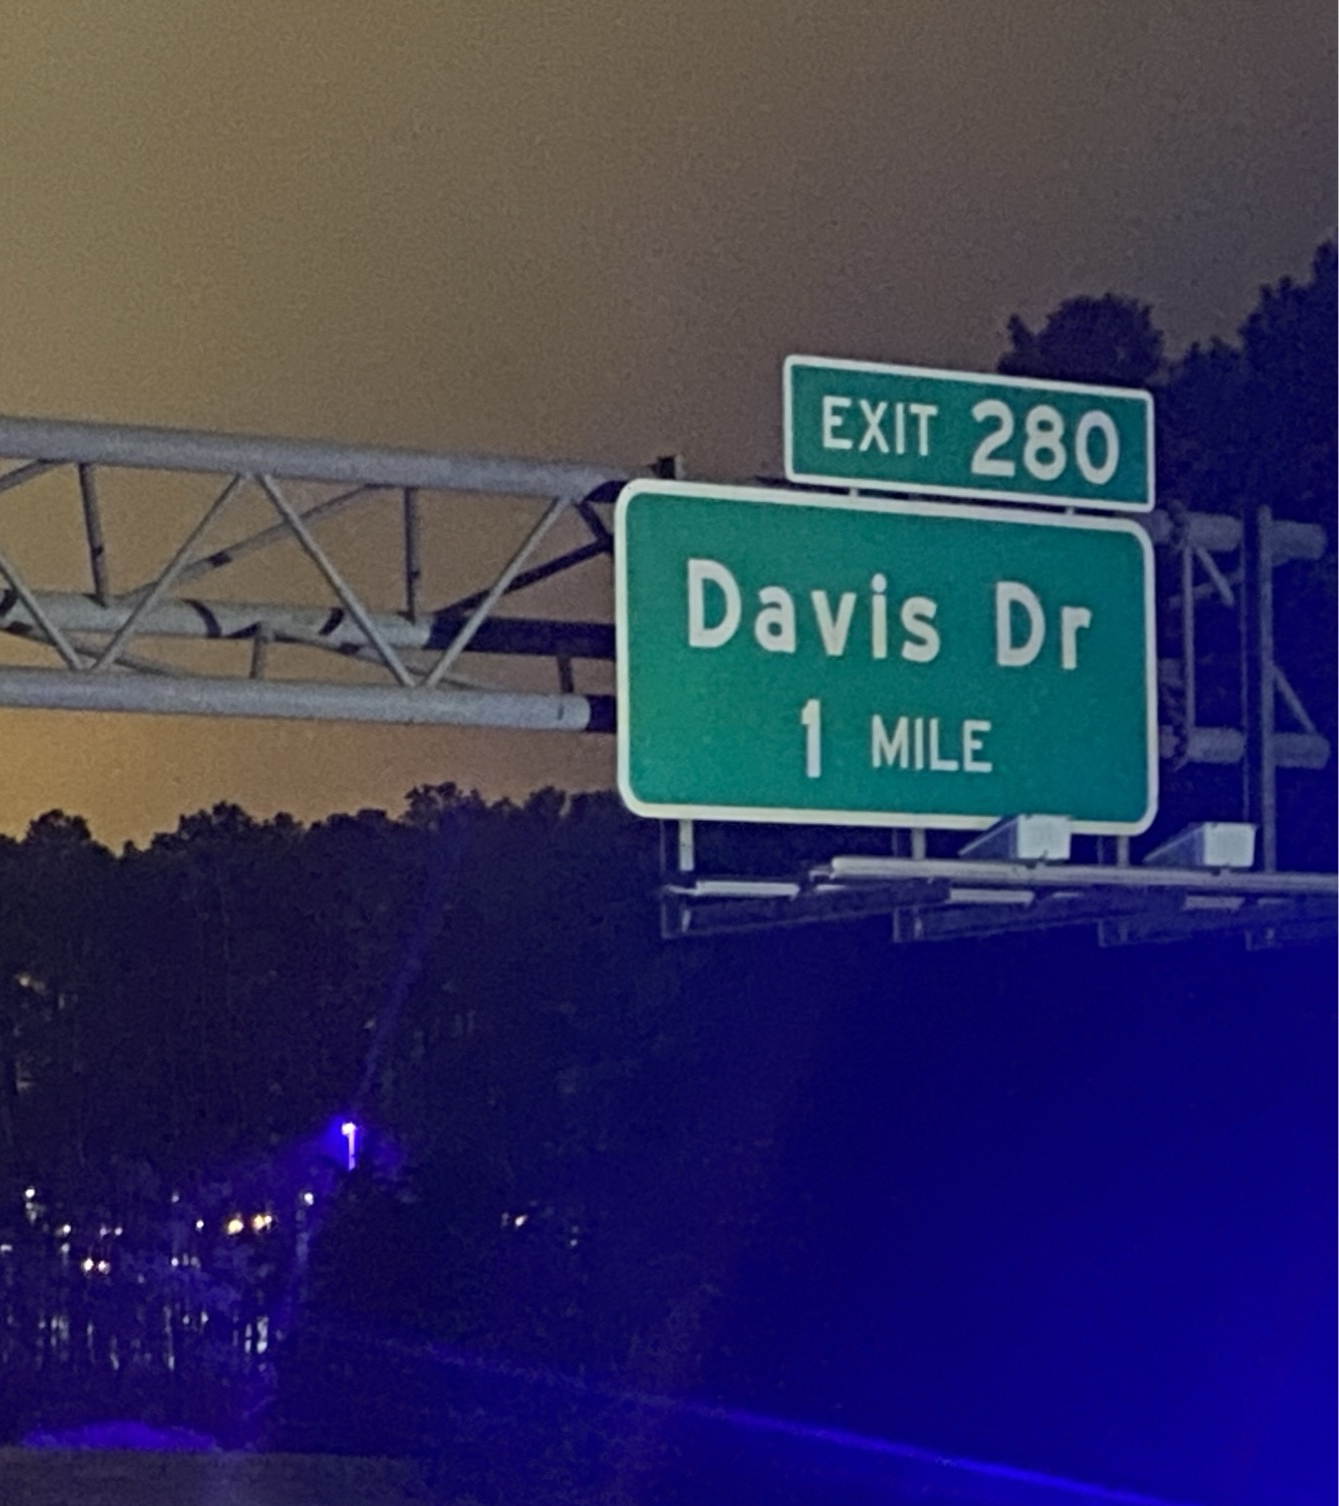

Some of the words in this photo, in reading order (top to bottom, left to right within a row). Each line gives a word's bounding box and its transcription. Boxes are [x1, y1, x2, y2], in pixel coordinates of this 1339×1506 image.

[821, 395, 938, 457] EXIT
[970, 398, 1120, 484] 280
[686, 557, 941, 664] Davis
[994, 580, 1093, 670] Dr
[799, 698, 821, 778] 1
[870, 713, 994, 773] MILE
